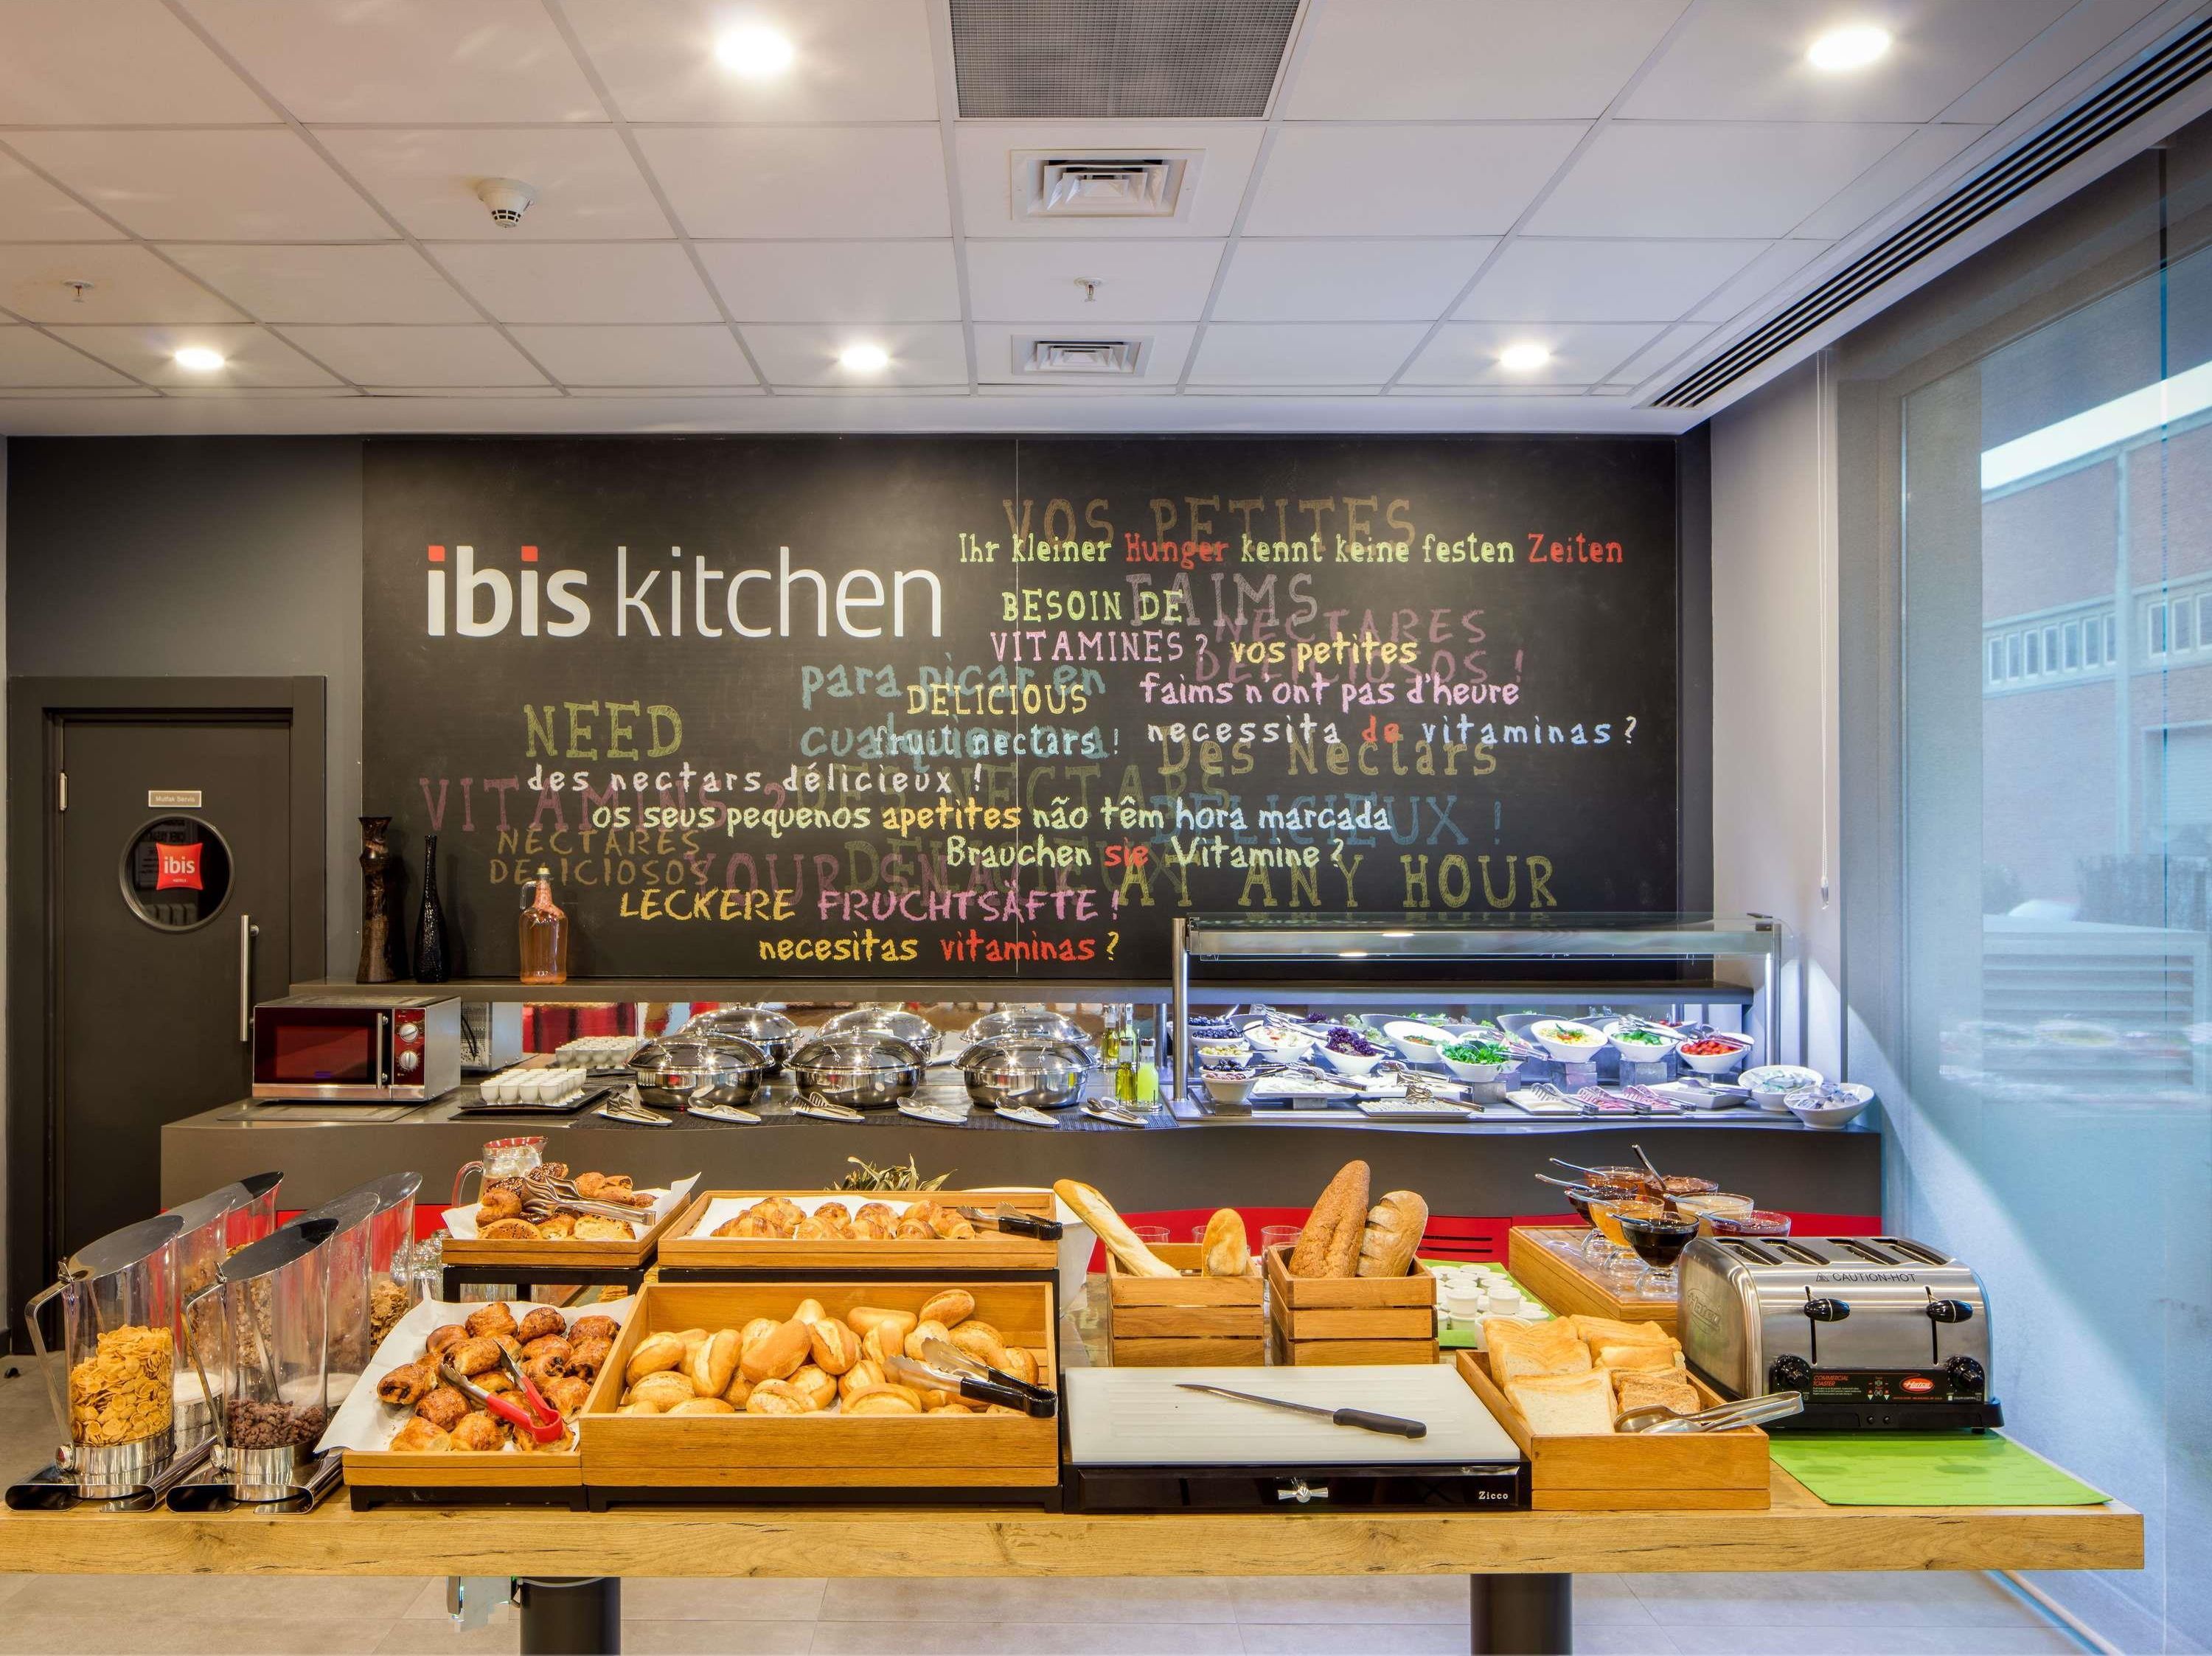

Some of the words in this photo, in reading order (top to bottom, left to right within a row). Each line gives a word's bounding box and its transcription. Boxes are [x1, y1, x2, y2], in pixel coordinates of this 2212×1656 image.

[1003, 498, 1115, 552] VOS
[1150, 495, 1416, 554] PETITES
[959, 532, 1000, 563] Ihr
[1012, 532, 1112, 563] kleiner
[1124, 532, 1230, 570] Hunger
[1241, 532, 1323, 563] kennt
[1335, 534, 1411, 563] keine
[1422, 532, 1515, 563] festen
[1528, 532, 1623, 563] Zeiten
[428, 545, 591, 637] ibis
[618, 545, 941, 638] kitchen
[1002, 588, 1121, 622] BESOIN
[1140, 588, 1183, 623] DE
[1126, 572, 1318, 627] FAIMS
[1214, 608, 1486, 644] NECTARES
[990, 629, 1183, 663] VITAMINES
[1195, 633, 1208, 662] ?
[1230, 641, 1287, 664] vos
[1296, 631, 1420, 674] petites
[801, 664, 903, 710] para
[919, 652, 1035, 712] picar
[1053, 664, 1106, 696] en
[906, 684, 1088, 716] DELICIOUS
[1140, 672, 1234, 706] faims
[1245, 672, 1330, 705] n'ont
[1341, 681, 1397, 714] pas
[1406, 672, 1520, 705] d'heure
[523, 700, 683, 761] NEED
[874, 723, 954, 756] fruit
[973, 723, 1096, 756] nectars
[1113, 728, 1119, 755] !
[1147, 713, 1341, 744] necessita
[1361, 714, 1403, 744] de
[1422, 713, 1612, 745] vitaminas
[1624, 715, 1638, 745] ?
[1158, 726, 1255, 775] Des
[1286, 726, 1497, 776] Nectars
[527, 762, 590, 792] des
[611, 762, 762, 793] nectars
[782, 762, 953, 793] délicieux
[974, 762, 982, 792] !
[419, 775, 727, 832] VITAMINS
[592, 807, 631, 829] os
[643, 807, 716, 829] seus
[726, 807, 872, 838] pequenos
[881, 797, 1023, 838] apetites
[1032, 796, 1089, 829] não
[1100, 795, 1165, 829] têm
[1176, 796, 1248, 829] hora
[1259, 799, 1393, 830] marcada
[497, 828, 700, 856] NECTARES
[947, 833, 1092, 869] Brauchen
[1103, 837, 1150, 867] sie
[1170, 835, 1320, 869] Vitamine
[1332, 838, 1344, 868] ?
[164, 855, 195, 874] ibis
[490, 857, 708, 886] DEICIOSOS
[1238, 854, 1365, 908] ANY
[1401, 854, 1557, 908] HOUR
[620, 887, 796, 922] LECKERE
[818, 880, 1099, 924] FRUCHTSÄFTE
[1112, 889, 1119, 921] !
[759, 929, 919, 962] necesitas
[939, 928, 1099, 962] vitaminas
[1105, 931, 1119, 961] ?
[1832, 1273, 1917, 1283] CAUTION-HOT
[1478, 1491, 1509, 1500] Zicco
